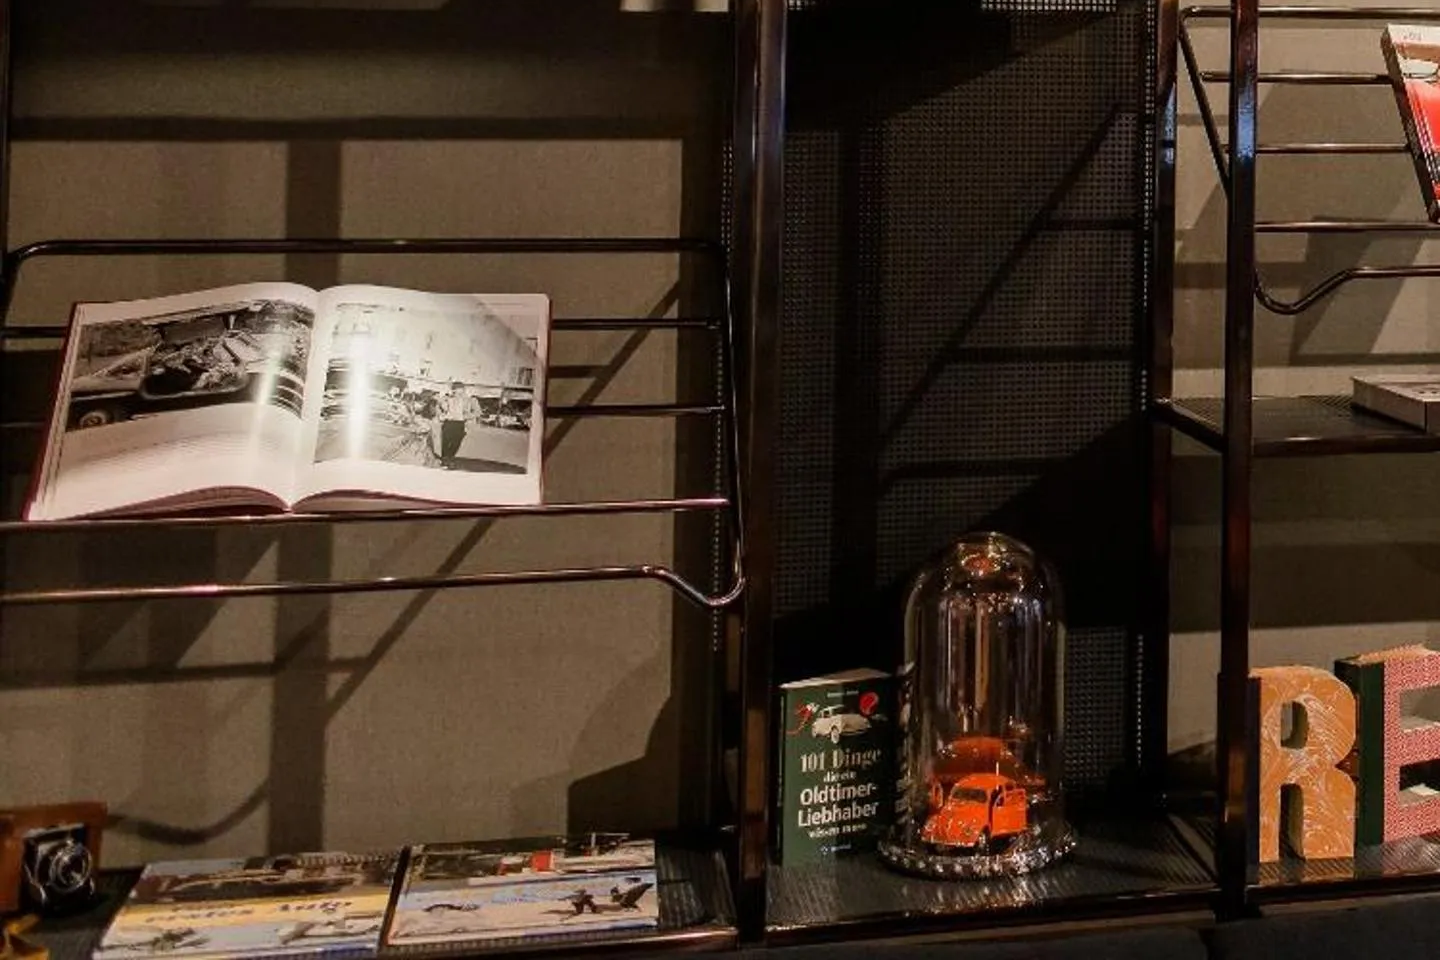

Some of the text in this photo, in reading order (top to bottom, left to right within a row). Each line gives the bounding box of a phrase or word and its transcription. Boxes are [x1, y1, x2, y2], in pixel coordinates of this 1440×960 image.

[800, 747, 881, 772] 101 Dinge
[800, 782, 877, 806] Oldtimer-
[798, 801, 880, 827] Liebhaber
